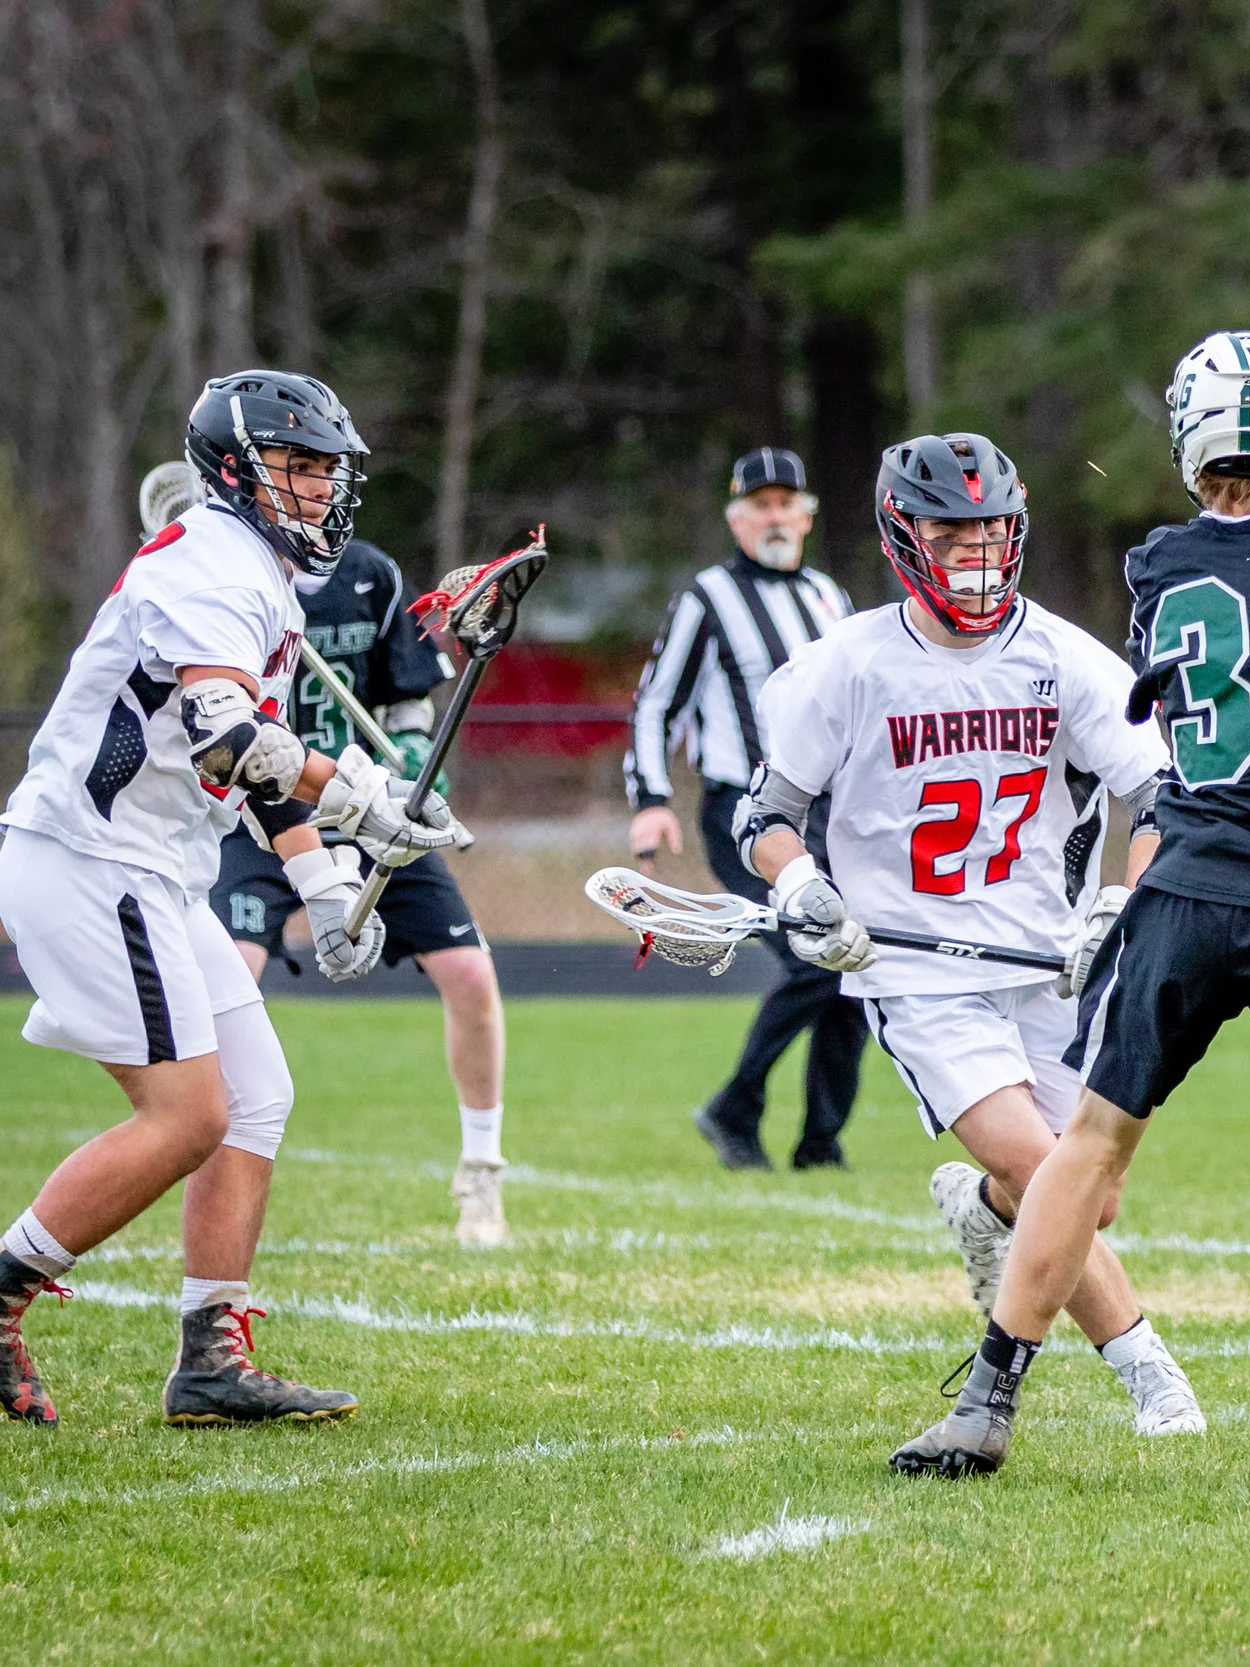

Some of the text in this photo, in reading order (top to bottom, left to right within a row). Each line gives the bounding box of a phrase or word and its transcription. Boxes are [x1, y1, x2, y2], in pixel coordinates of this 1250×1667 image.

[886, 706, 1060, 769] WARRIORS
[910, 765, 1048, 896] 27
[229, 892, 266, 933] 13
[935, 940, 986, 959] STX
